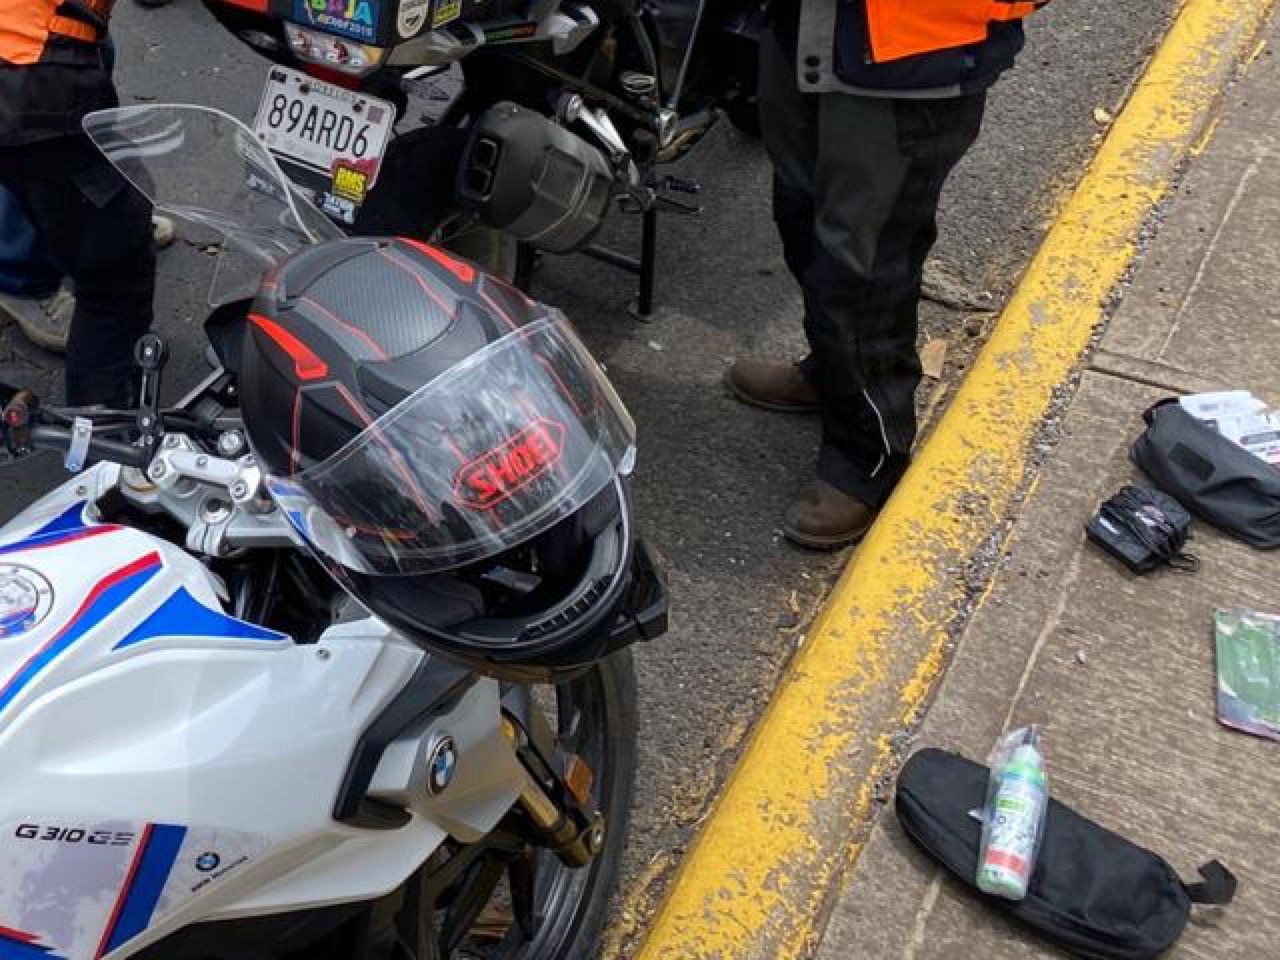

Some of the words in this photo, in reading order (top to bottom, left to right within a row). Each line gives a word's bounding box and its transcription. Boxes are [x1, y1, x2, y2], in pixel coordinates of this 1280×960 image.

[268, 93, 371, 158] 89ARD6
[14, 823, 39, 839] G
[40, 826, 85, 843] 310
[87, 830, 135, 846] GS
